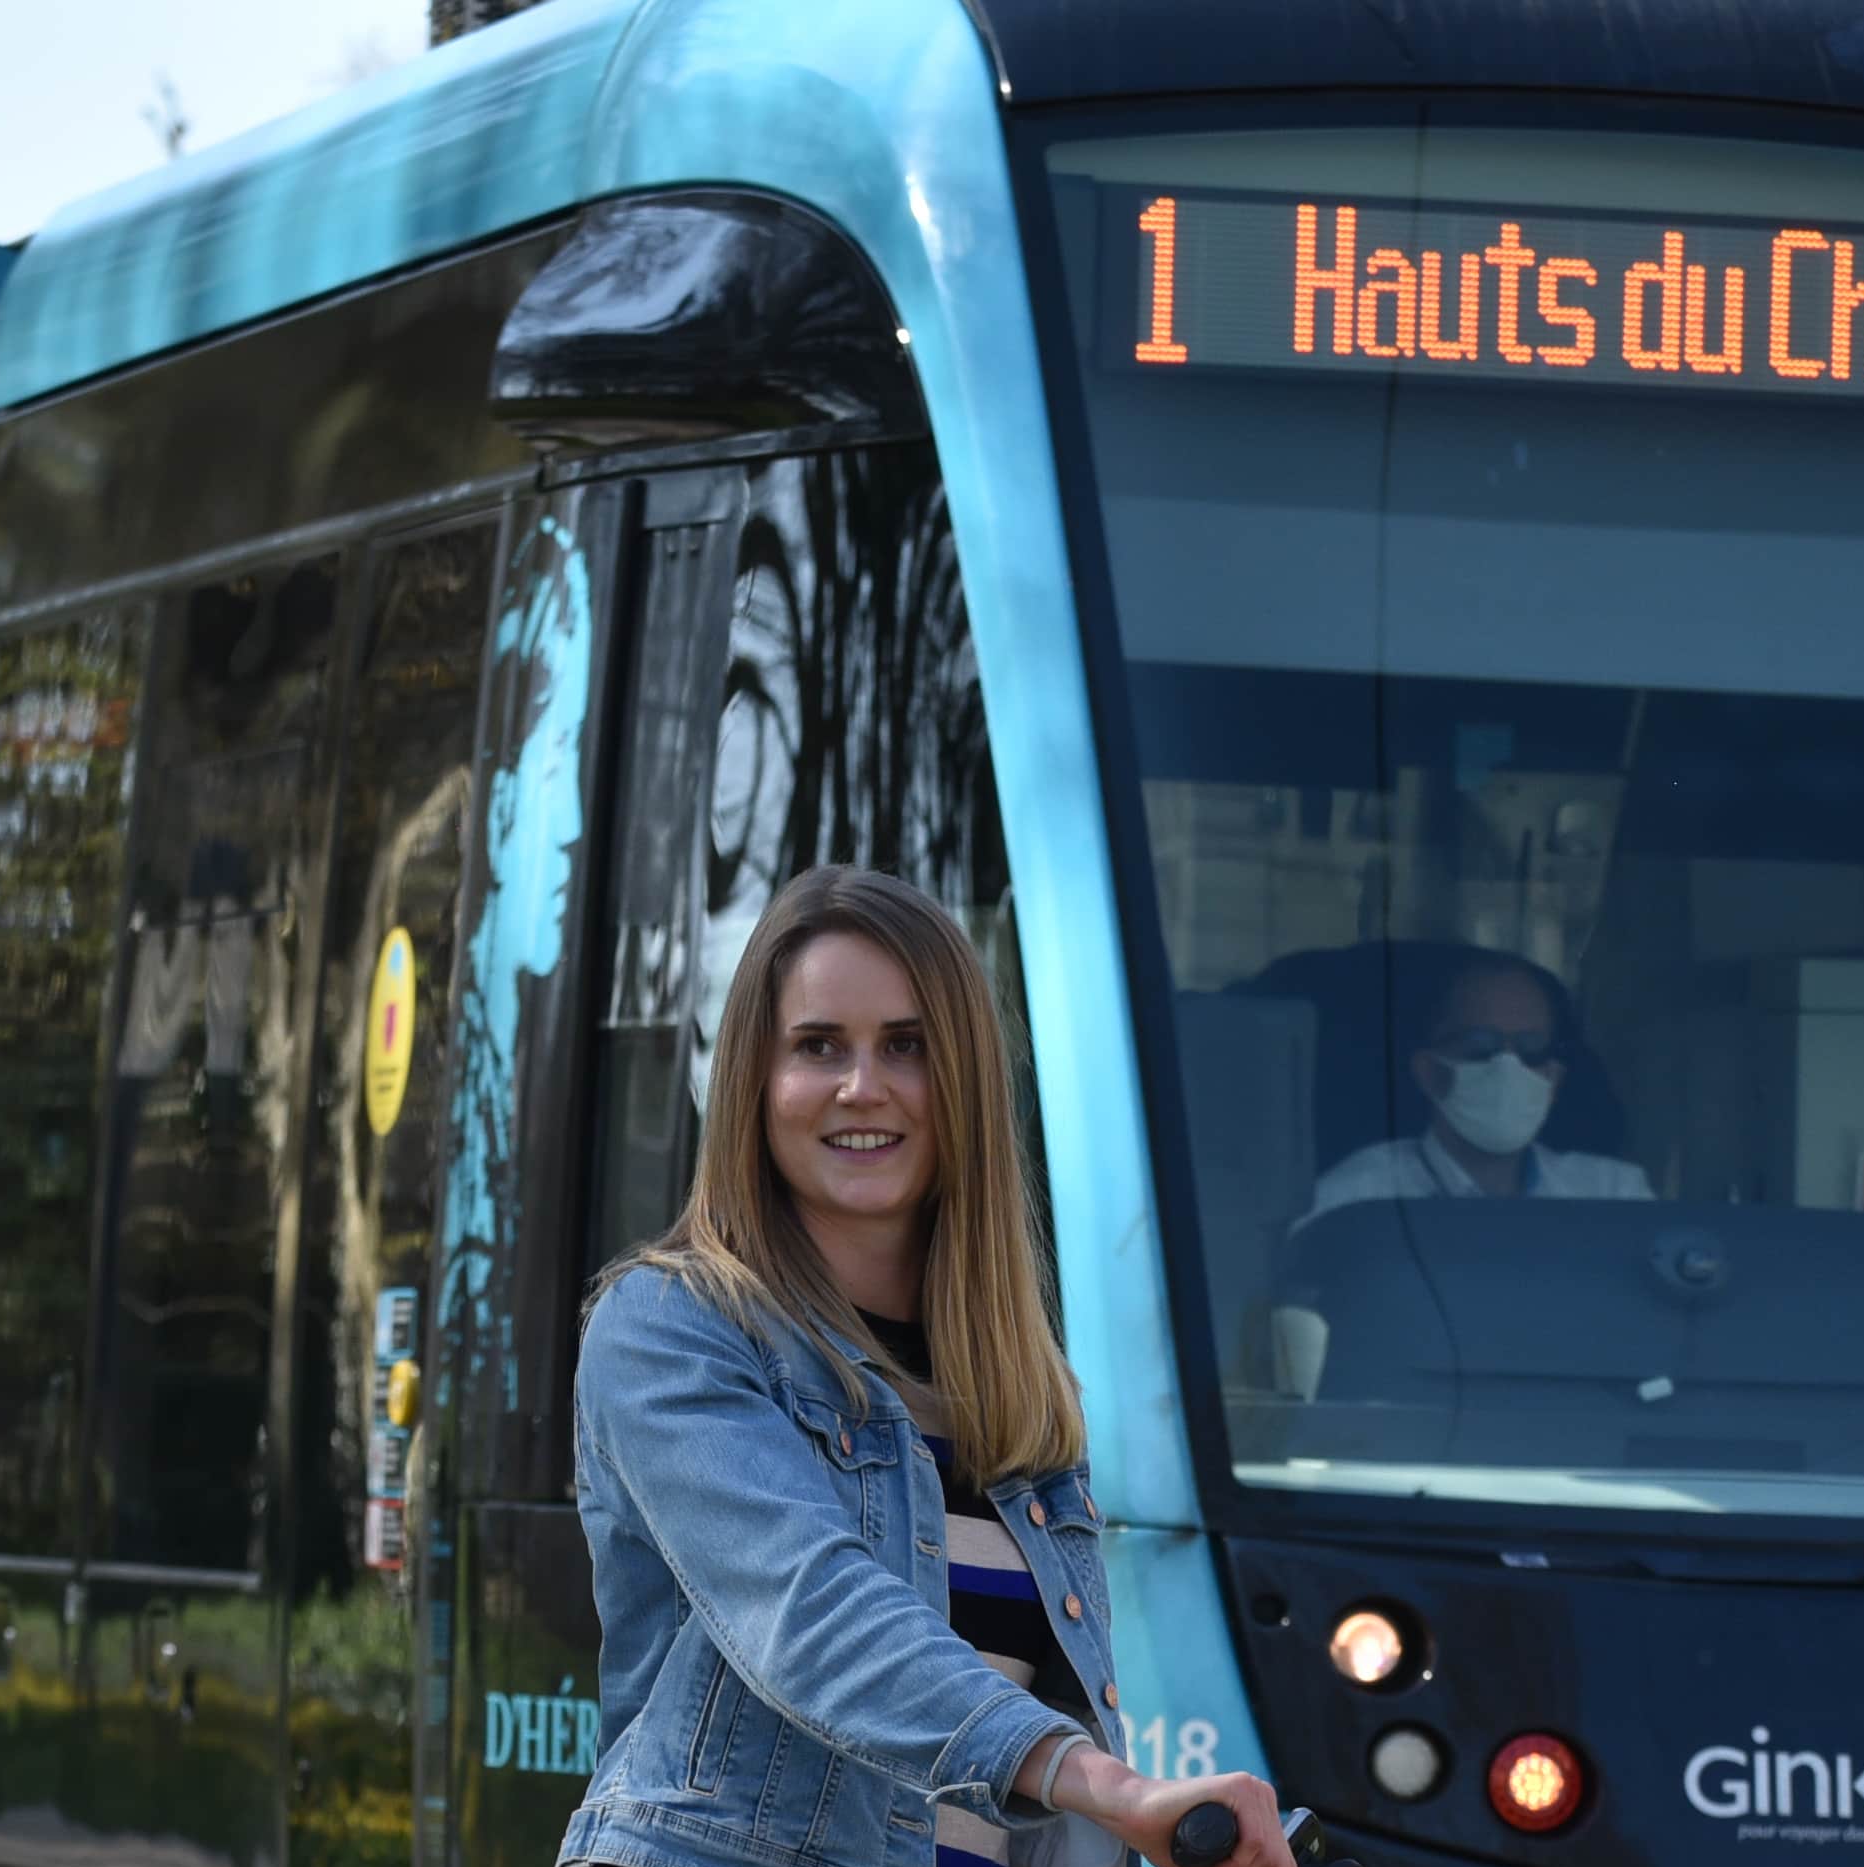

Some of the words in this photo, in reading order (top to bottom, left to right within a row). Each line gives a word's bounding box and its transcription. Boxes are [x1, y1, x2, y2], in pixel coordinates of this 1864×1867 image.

[1134, 197, 1188, 364] 1
[1292, 203, 1598, 368] Hauts
[1621, 230, 1744, 376] du
